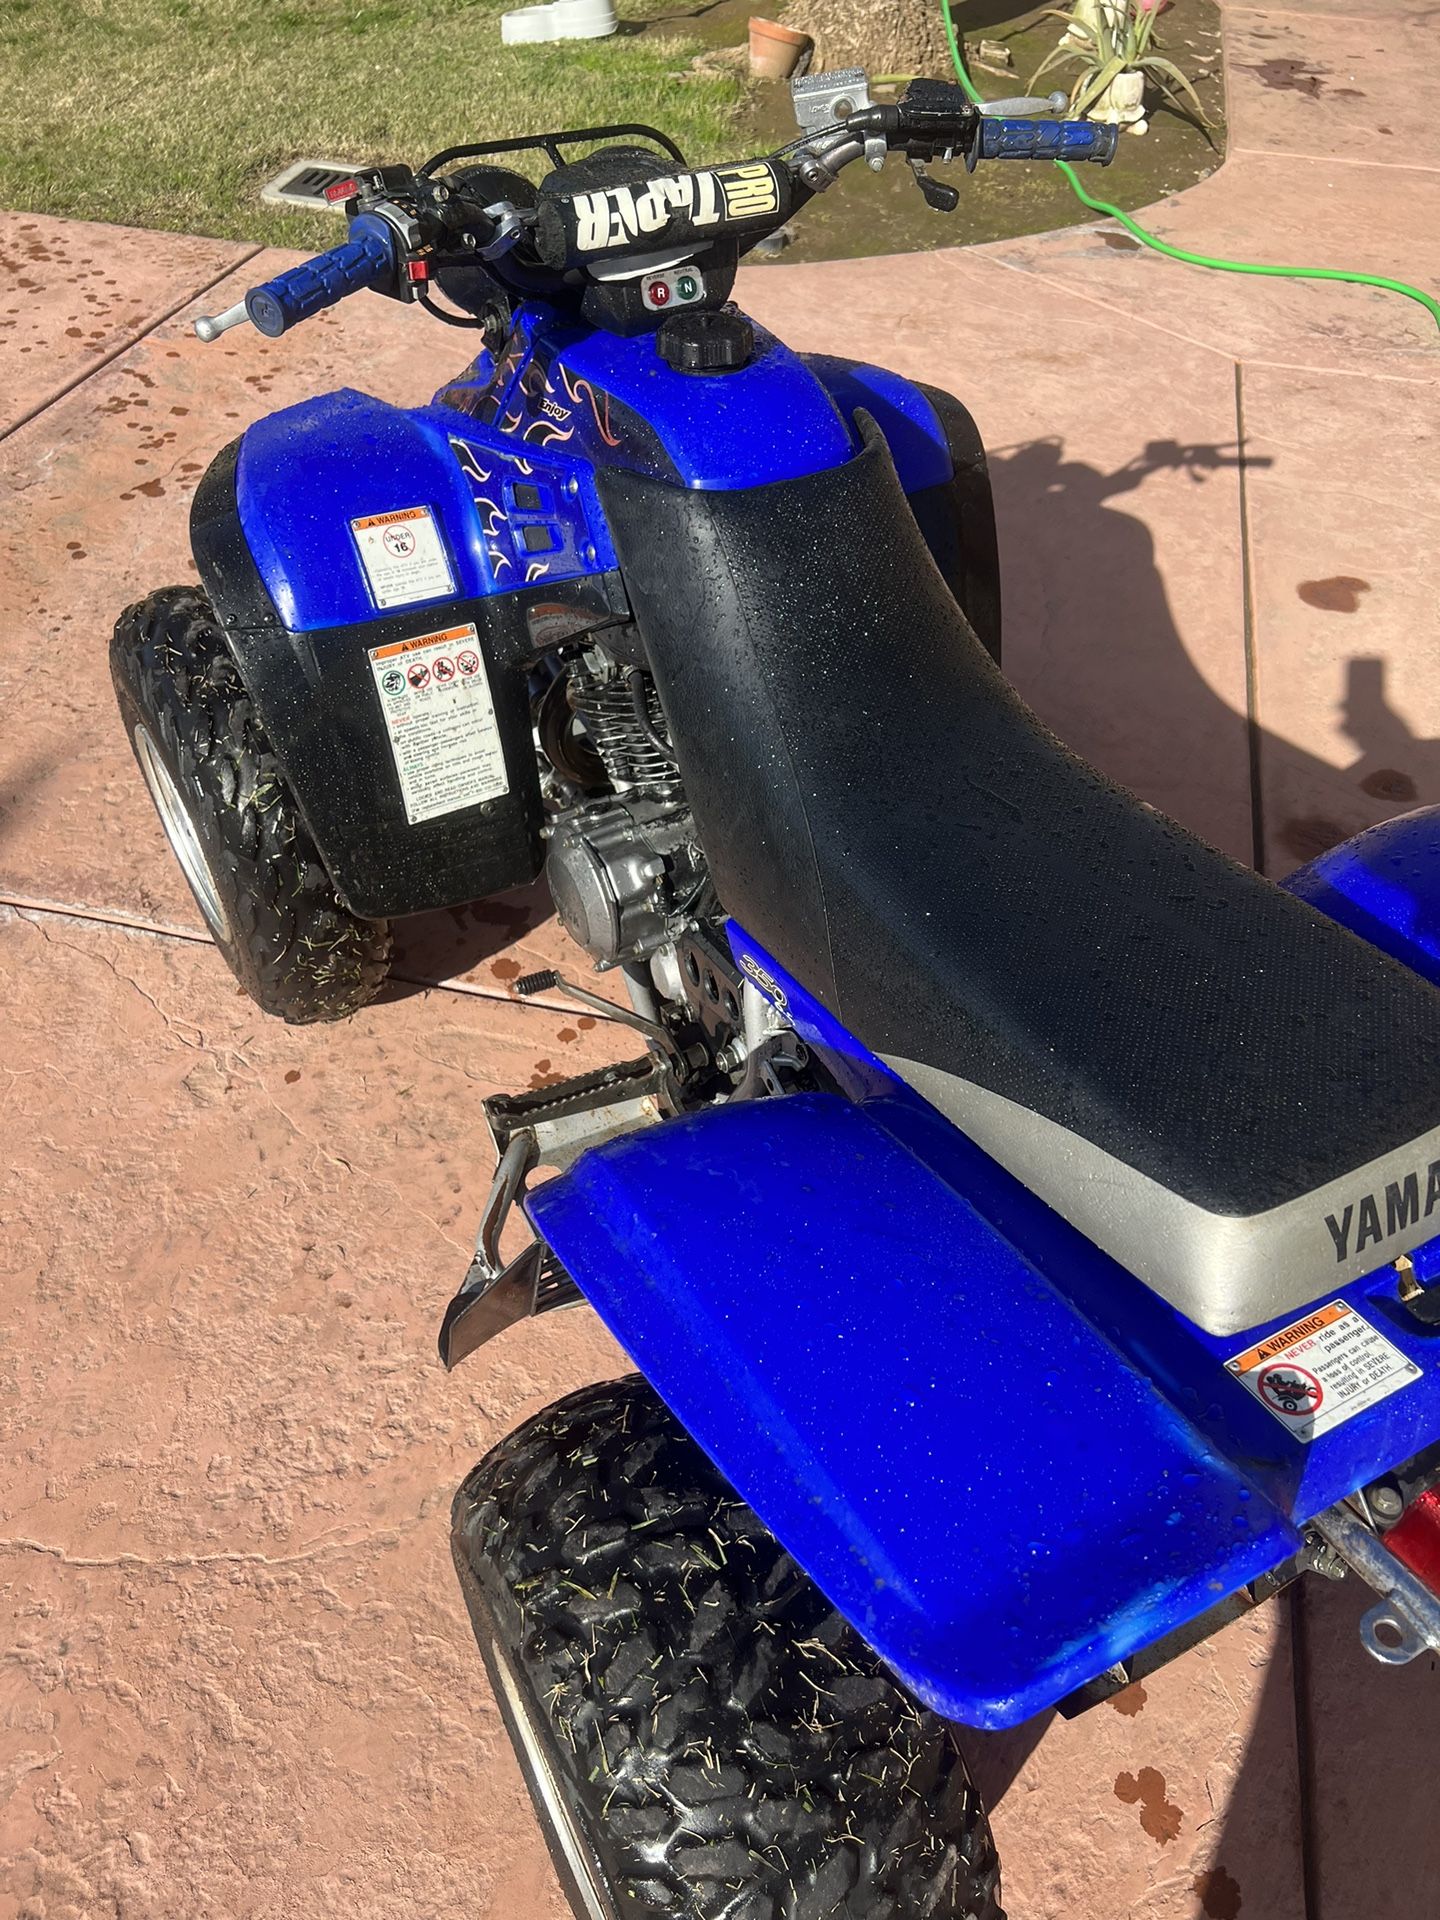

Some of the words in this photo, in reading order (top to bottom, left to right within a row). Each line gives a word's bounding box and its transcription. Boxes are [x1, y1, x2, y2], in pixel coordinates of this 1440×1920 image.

[715, 163, 777, 218] PRO
[573, 171, 721, 251] TAPER
[657, 287, 665, 298] R
[684, 280, 693, 293] N
[539, 398, 570, 420] Enjoy
[377, 511, 416, 524] WARNING
[386, 532, 410, 542] UNDER
[395, 542, 408, 552] 16
[410, 633, 447, 648] WARNING
[740, 954, 787, 1006] 350
[1324, 1159, 1440, 1263] YAMA
[1267, 1317, 1324, 1351] WARNING
[1285, 1340, 1316, 1360] NEVER
[1319, 1330, 1336, 1341] ride
[1339, 1322, 1350, 1330] as
[1324, 1326, 1369, 1353] passenger.
[1312, 1353, 1348, 1374] Passengers
[1349, 1346, 1361, 1354] can
[1361, 1336, 1379, 1347] cause
[1326, 1369, 1342, 1378] loss
[1342, 1363, 1350, 1371] of
[1330, 1371, 1359, 1390] resulting
[1364, 1353, 1390, 1370] SEVERE
[1338, 1382, 1361, 1398] INJURY
